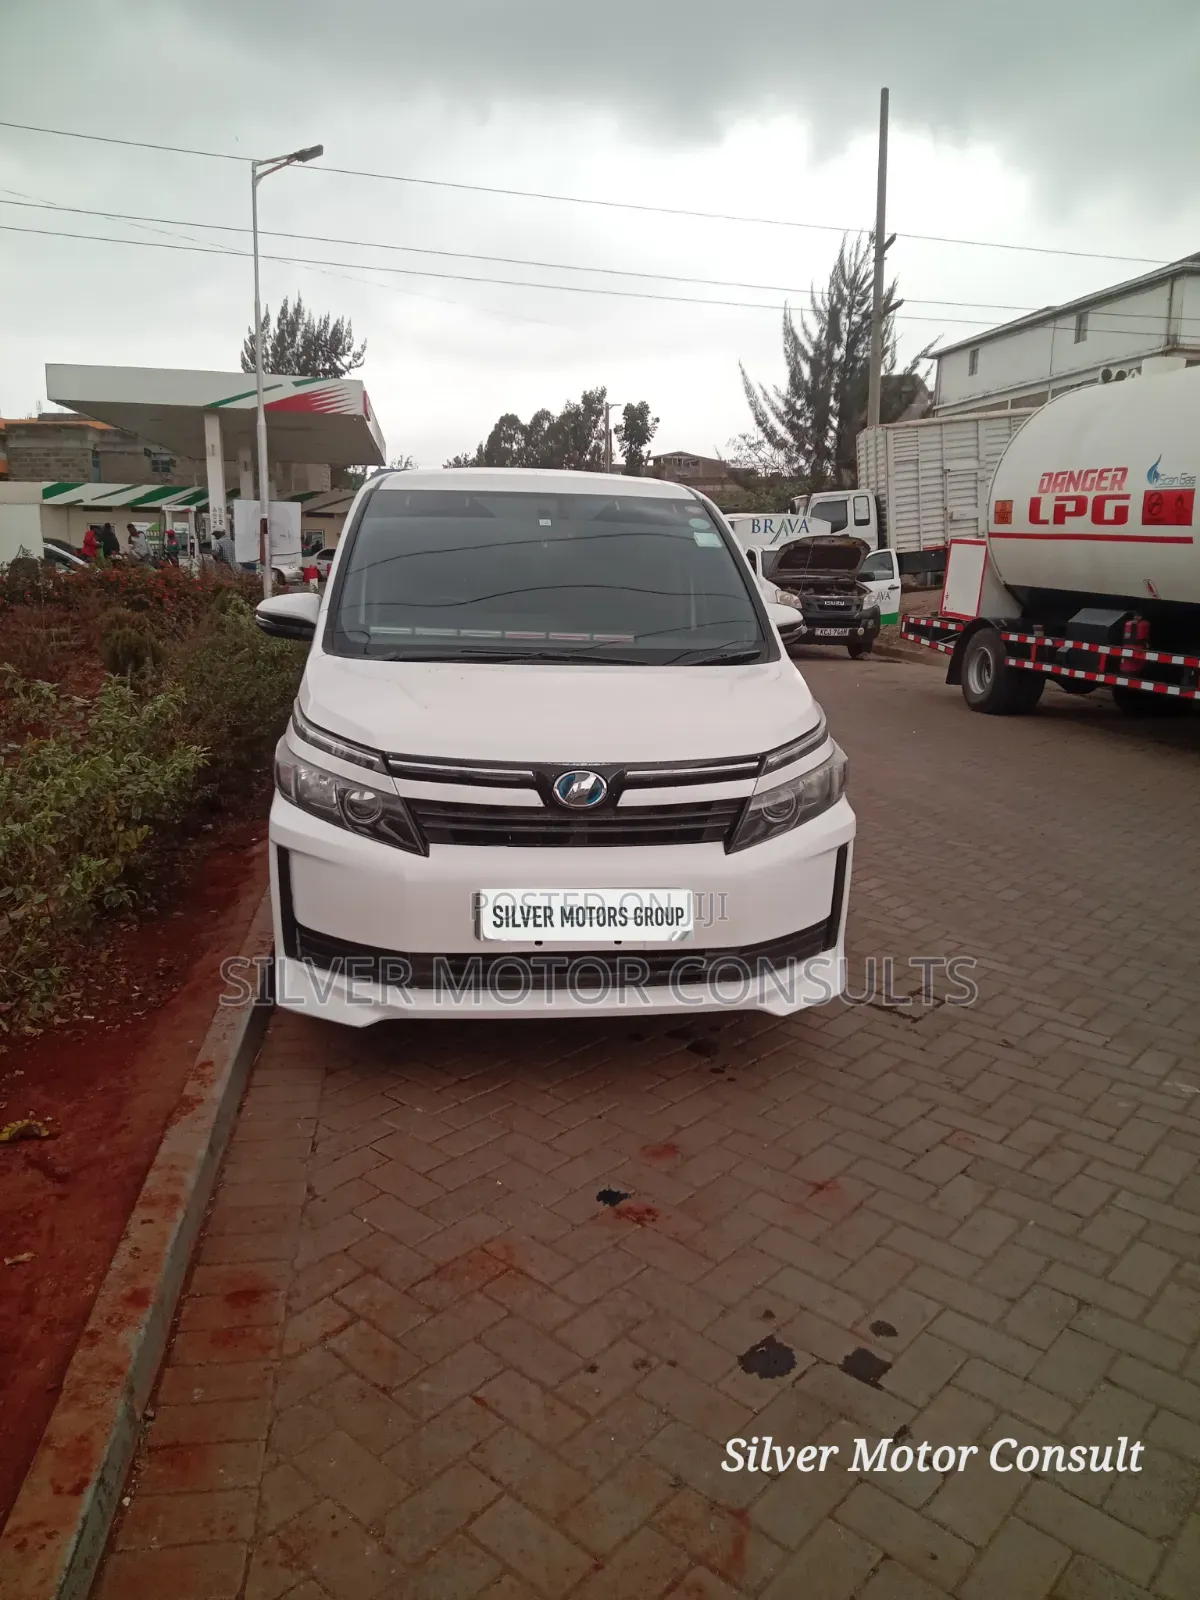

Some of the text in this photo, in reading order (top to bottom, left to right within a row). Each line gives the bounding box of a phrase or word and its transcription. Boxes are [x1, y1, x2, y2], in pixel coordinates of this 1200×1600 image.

[1037, 467, 1128, 494] DANGER
[1028, 494, 1131, 525] LPG
[751, 518, 810, 545] BRAVA
[492, 905, 685, 928] SILVER MOTORS GROUP
